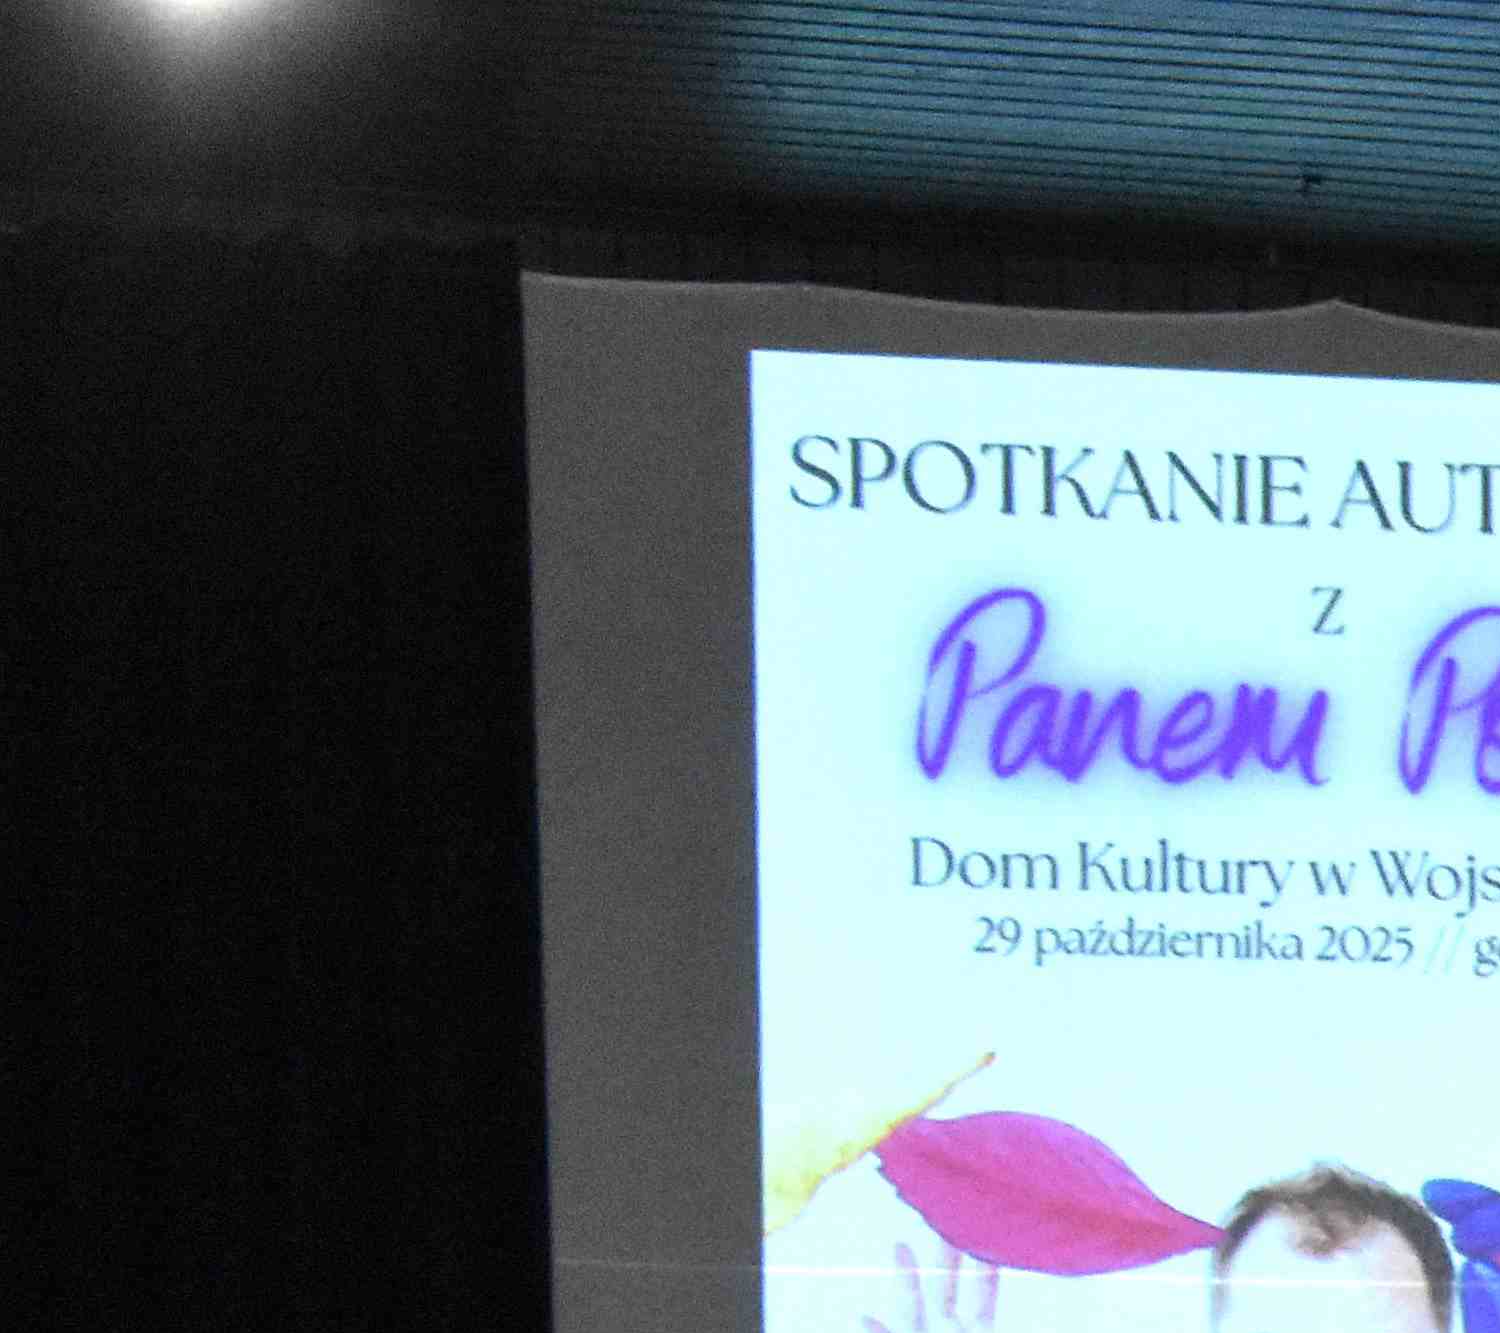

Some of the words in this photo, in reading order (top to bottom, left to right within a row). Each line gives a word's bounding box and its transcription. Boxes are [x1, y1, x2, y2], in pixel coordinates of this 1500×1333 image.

[789, 434, 1310, 528] SPOTKANIE
[911, 586, 1331, 786] Panem
[909, 836, 1060, 889] Dom
[1077, 838, 1295, 908] Kultury
[1308, 859, 1357, 898] w
[973, 916, 1023, 956] 29
[1034, 916, 1304, 966] października
[1315, 925, 1414, 967] 2025
